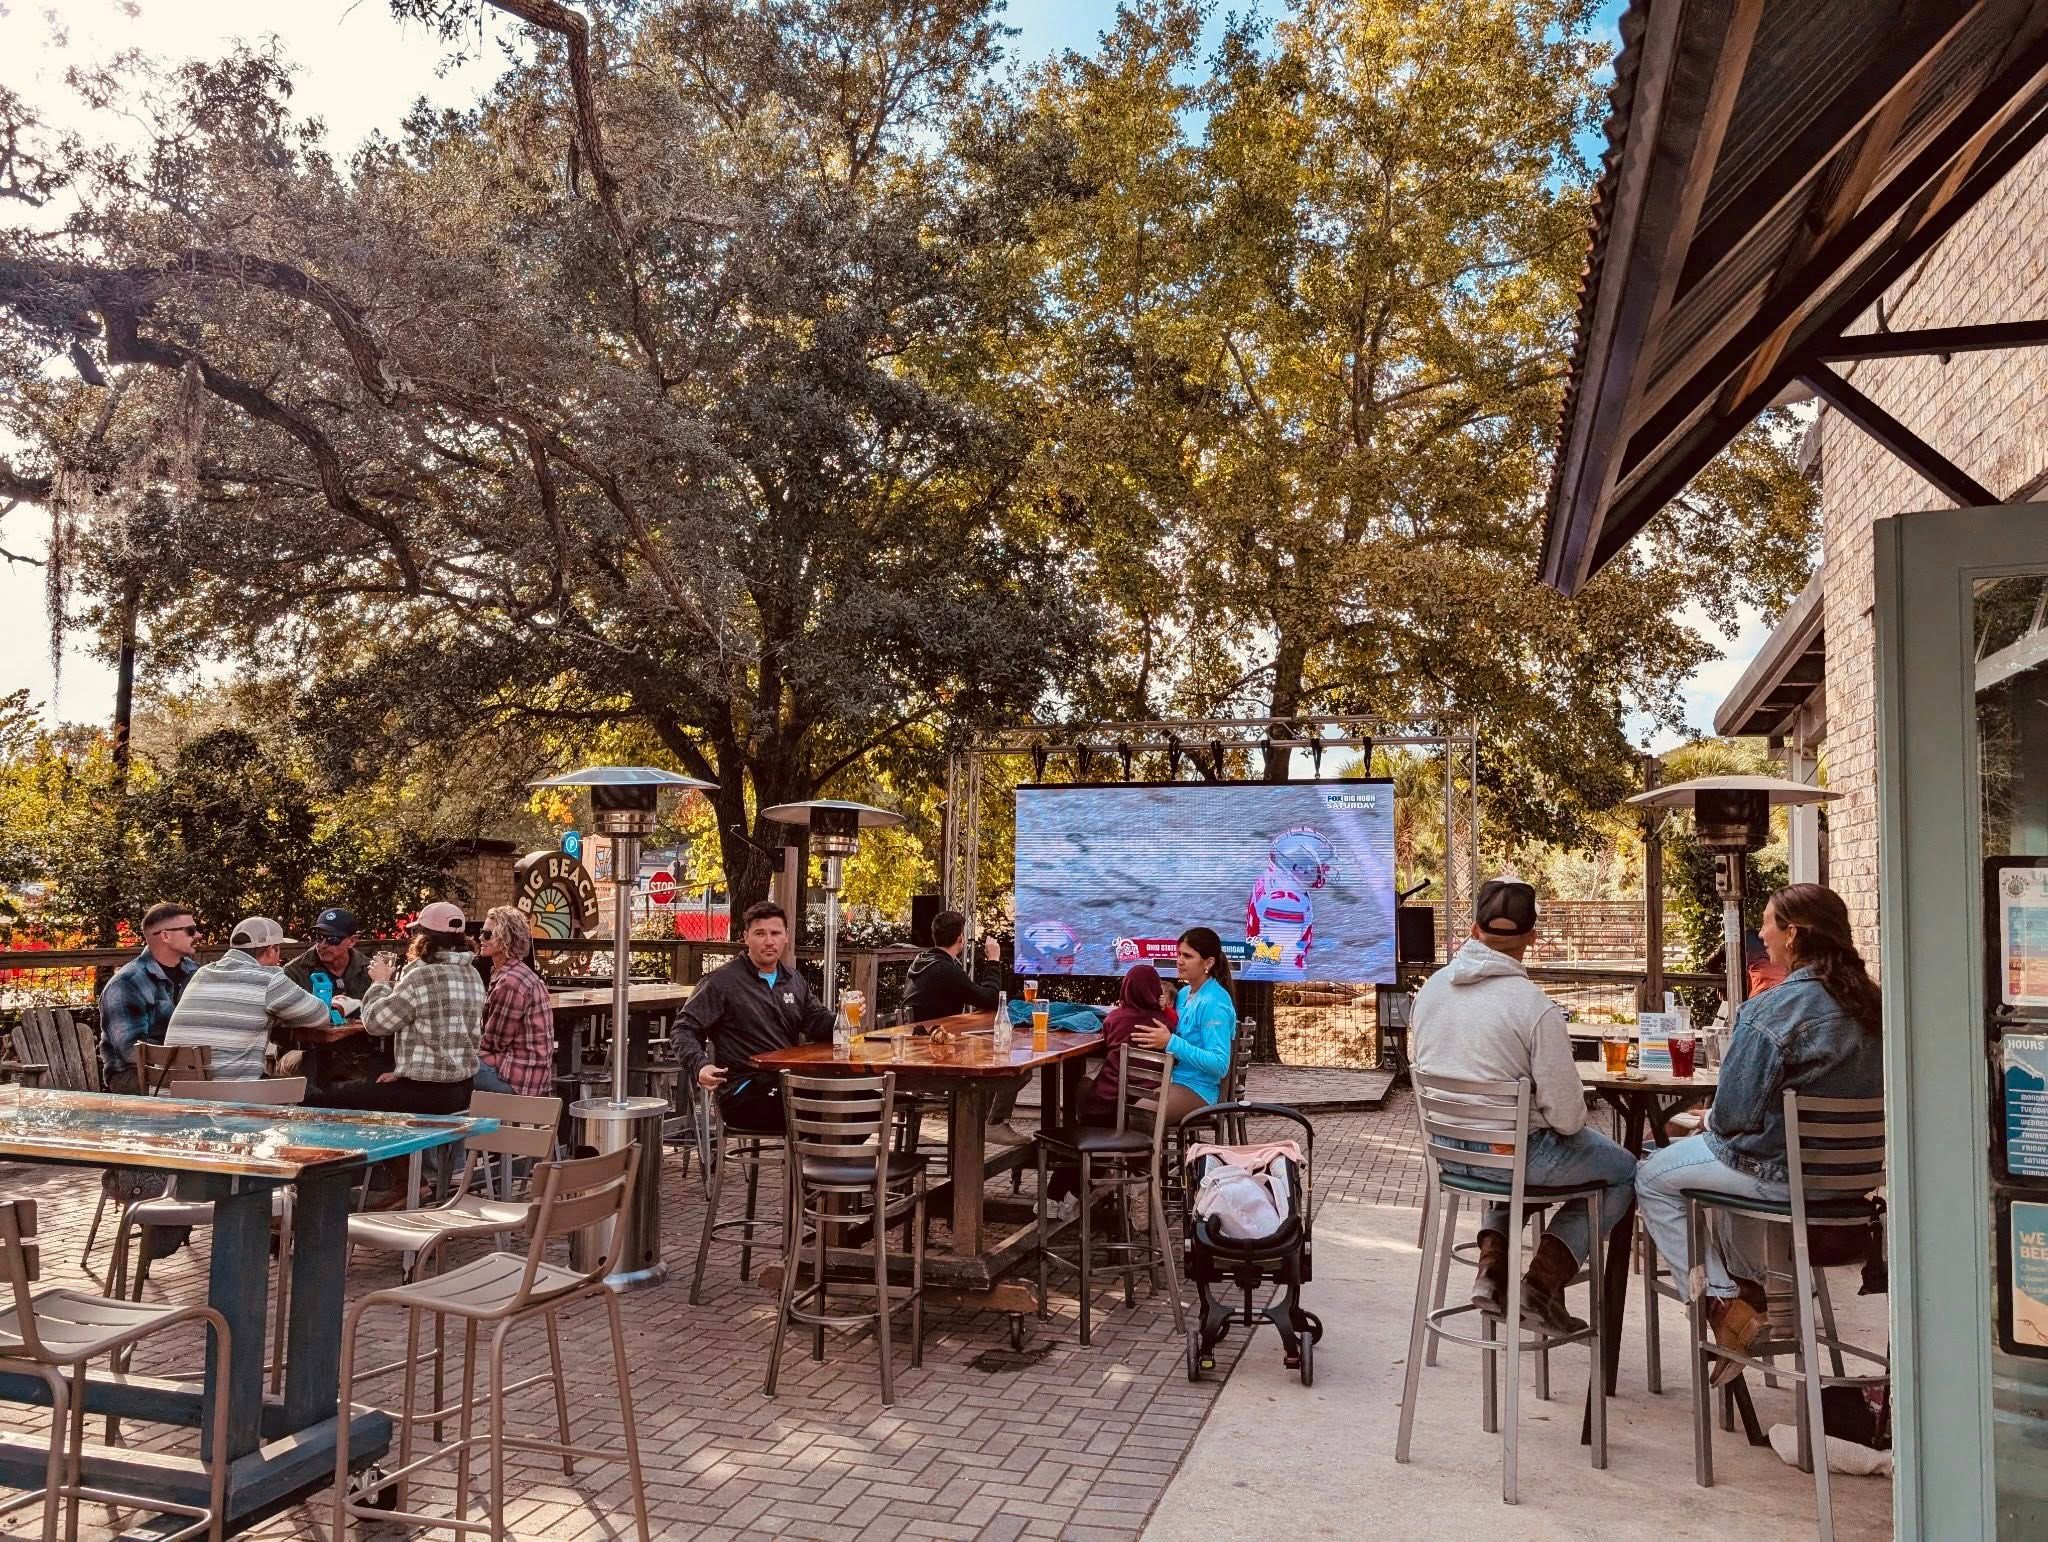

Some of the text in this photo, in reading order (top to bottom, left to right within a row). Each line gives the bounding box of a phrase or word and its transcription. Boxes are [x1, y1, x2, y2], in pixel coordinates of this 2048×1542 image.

[518, 858, 598, 917] BIG BEACH
[650, 881, 675, 894] STOP
[1160, 944, 1177, 952] STATE
[2007, 1039, 2045, 1051] HOURS
[2021, 1144, 2047, 1153] FRIDAY
[2019, 1231, 2046, 1246] WE
